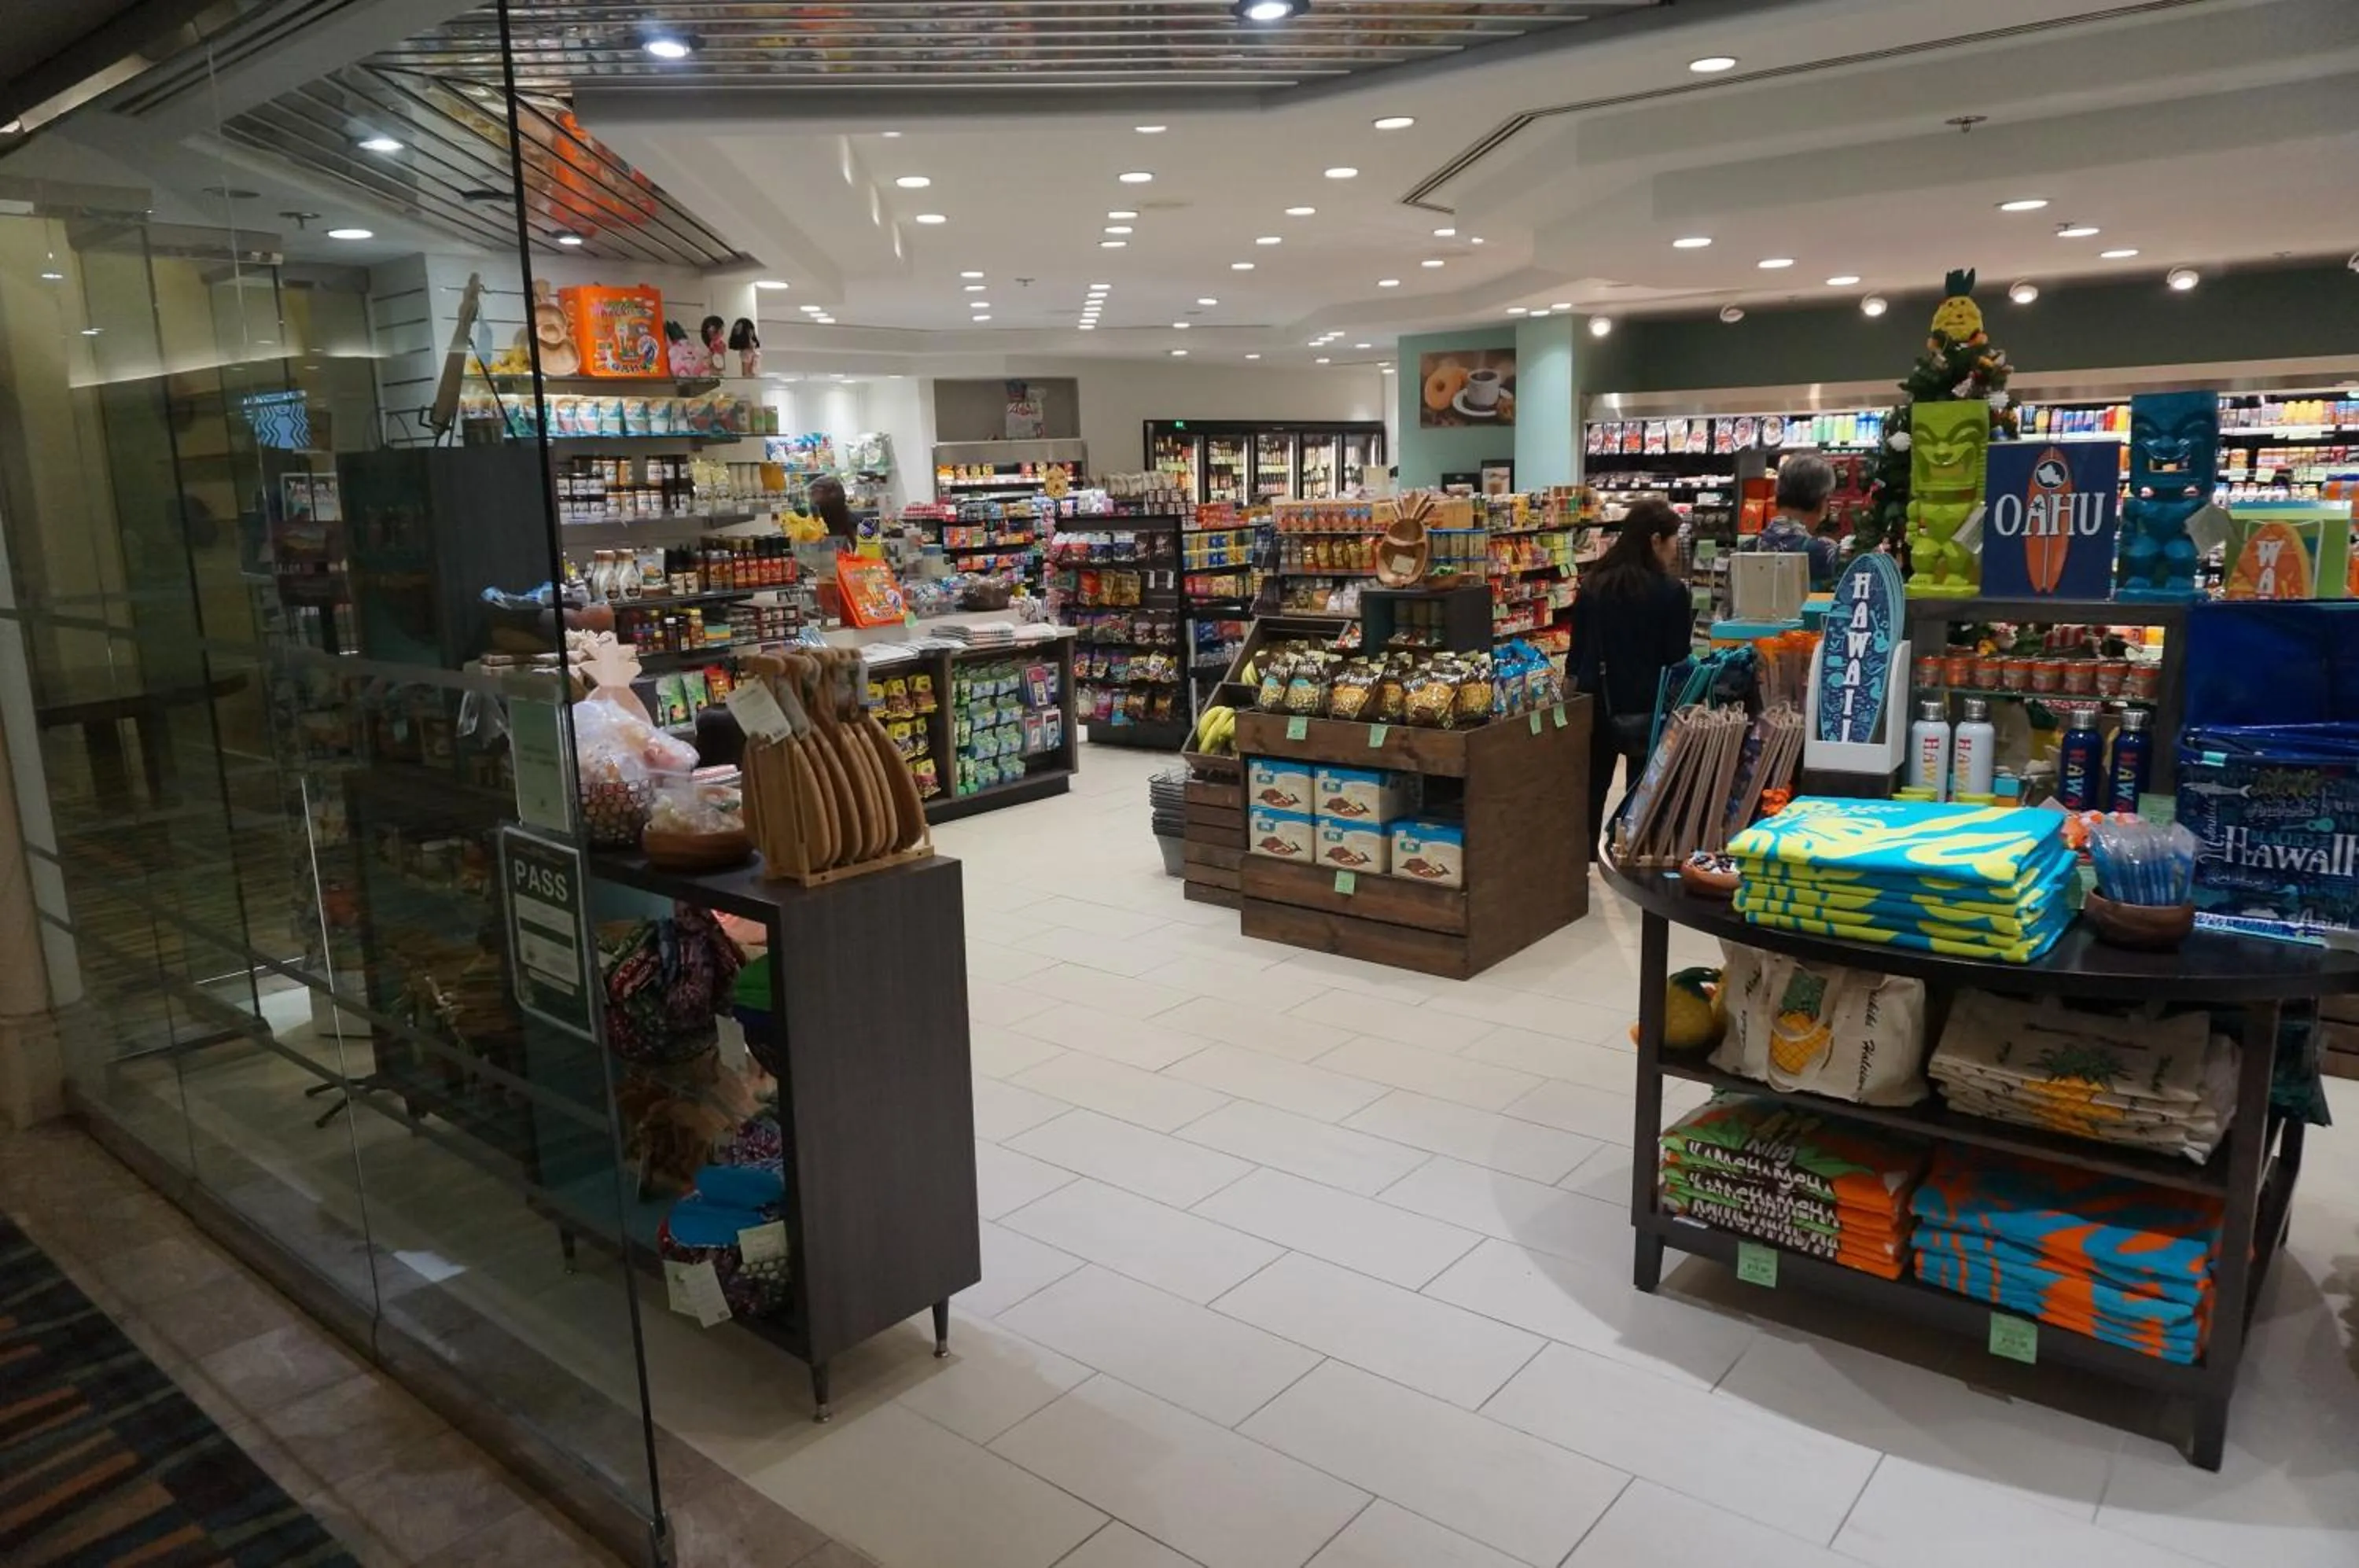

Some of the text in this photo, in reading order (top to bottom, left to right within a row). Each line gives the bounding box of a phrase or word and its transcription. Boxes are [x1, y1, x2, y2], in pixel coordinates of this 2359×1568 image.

[1994, 492, 2105, 536] OAHU
[1841, 572, 1873, 742] HAWAII
[514, 859, 568, 902] PASS
